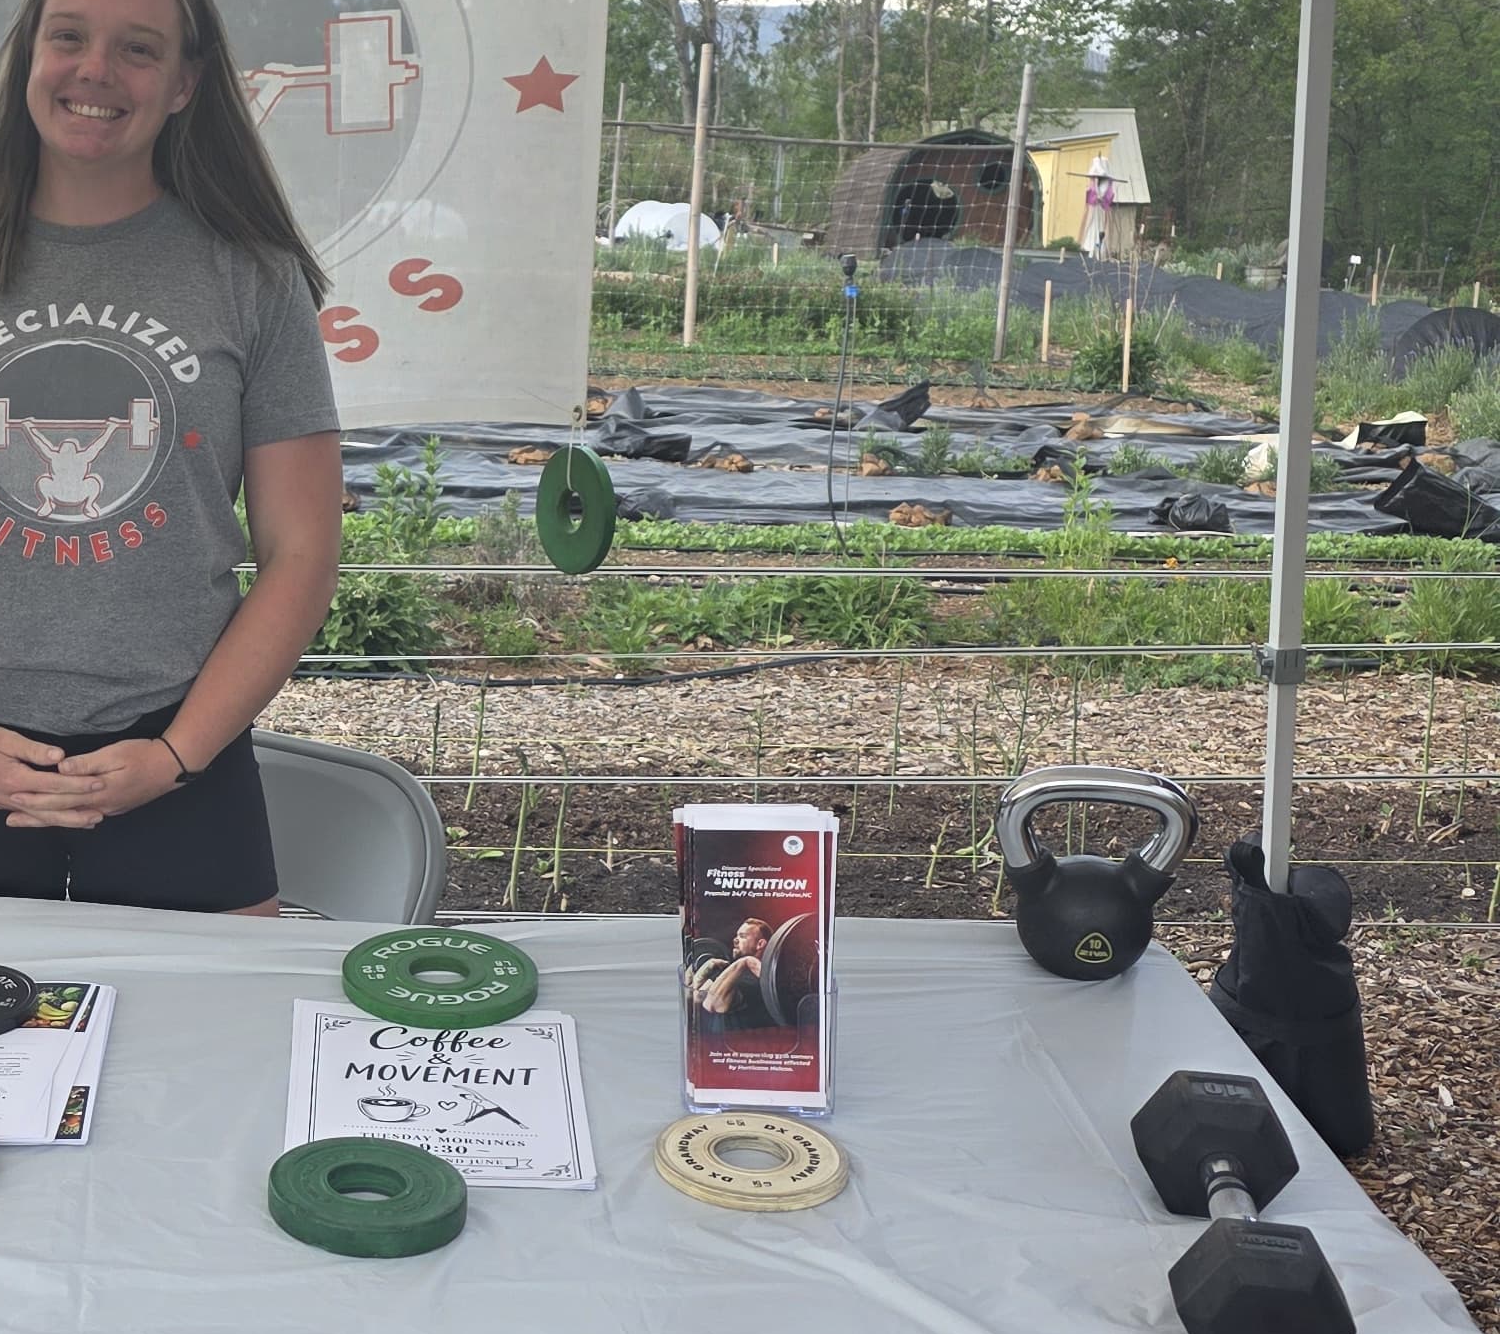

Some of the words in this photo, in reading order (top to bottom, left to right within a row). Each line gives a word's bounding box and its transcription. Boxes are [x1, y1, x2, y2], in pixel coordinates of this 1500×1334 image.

[706, 868, 746, 878] Fitness
[372, 936, 493, 960] ROGUE
[361, 964, 387, 974] 2.5
[385, 981, 510, 1005] ROGUE
[368, 1025, 512, 1054] Coffee
[427, 1052, 453, 1065] &
[344, 1061, 539, 1086] MOVEMENT
[359, 1131, 432, 1142] TUESDAY
[438, 1136, 527, 1147] MORNINGS
[419, 1143, 468, 1155] 9:30
[678, 1124, 709, 1171] GRANDWAY
[763, 1124, 789, 1135] DX
[790, 1134, 821, 1182] GRANDWAY
[469, 1157, 503, 1166] JUNE
[708, 1171, 734, 1183] DX
